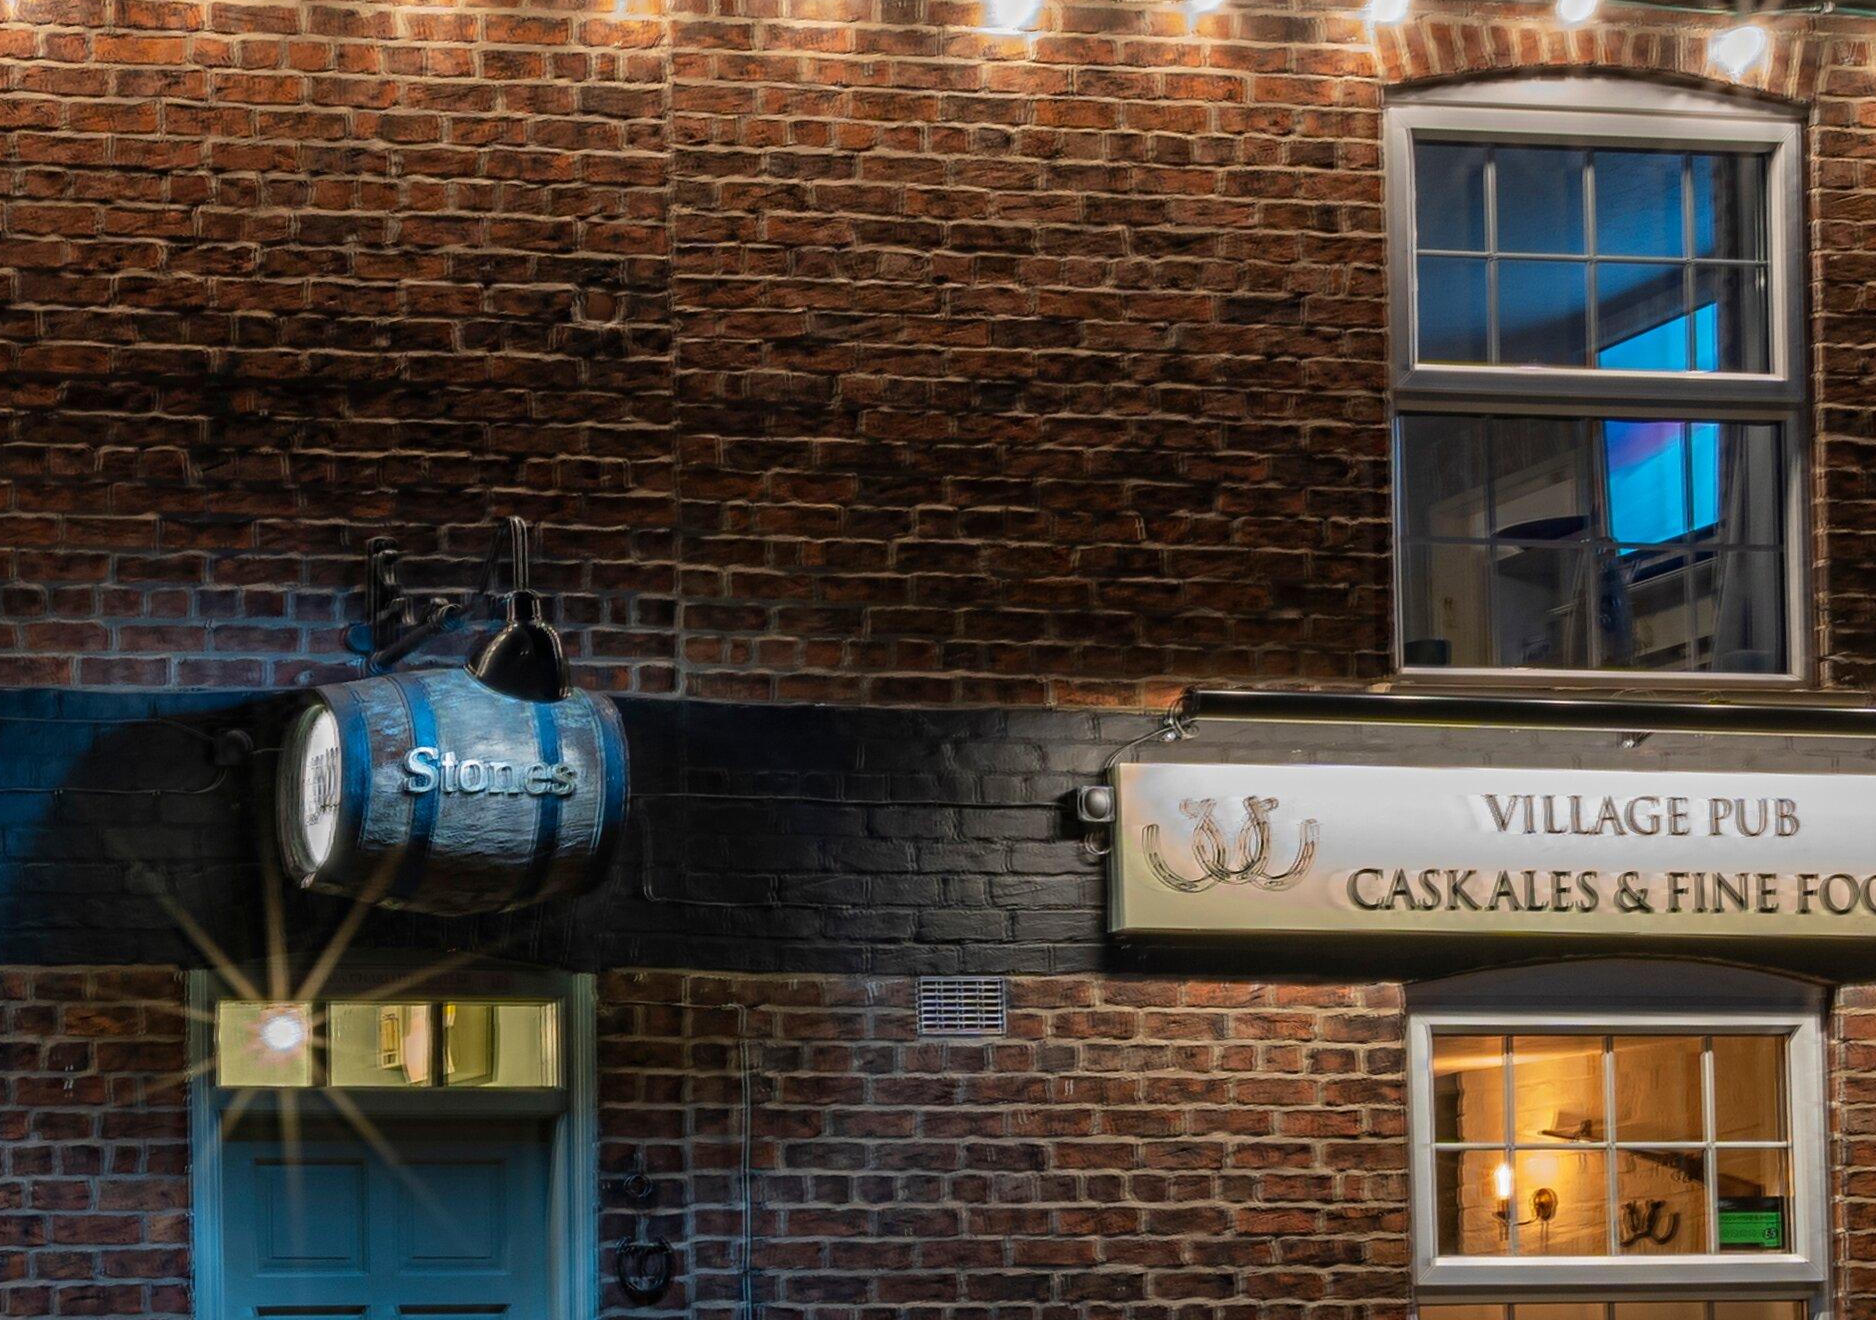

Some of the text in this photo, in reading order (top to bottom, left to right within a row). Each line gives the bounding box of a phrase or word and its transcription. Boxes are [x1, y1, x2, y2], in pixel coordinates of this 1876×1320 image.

[403, 746, 576, 796] Stones
[1481, 794, 1800, 837] VILLAGE PUB
[1613, 871, 1654, 913] &
[1665, 871, 1780, 914] FINE
